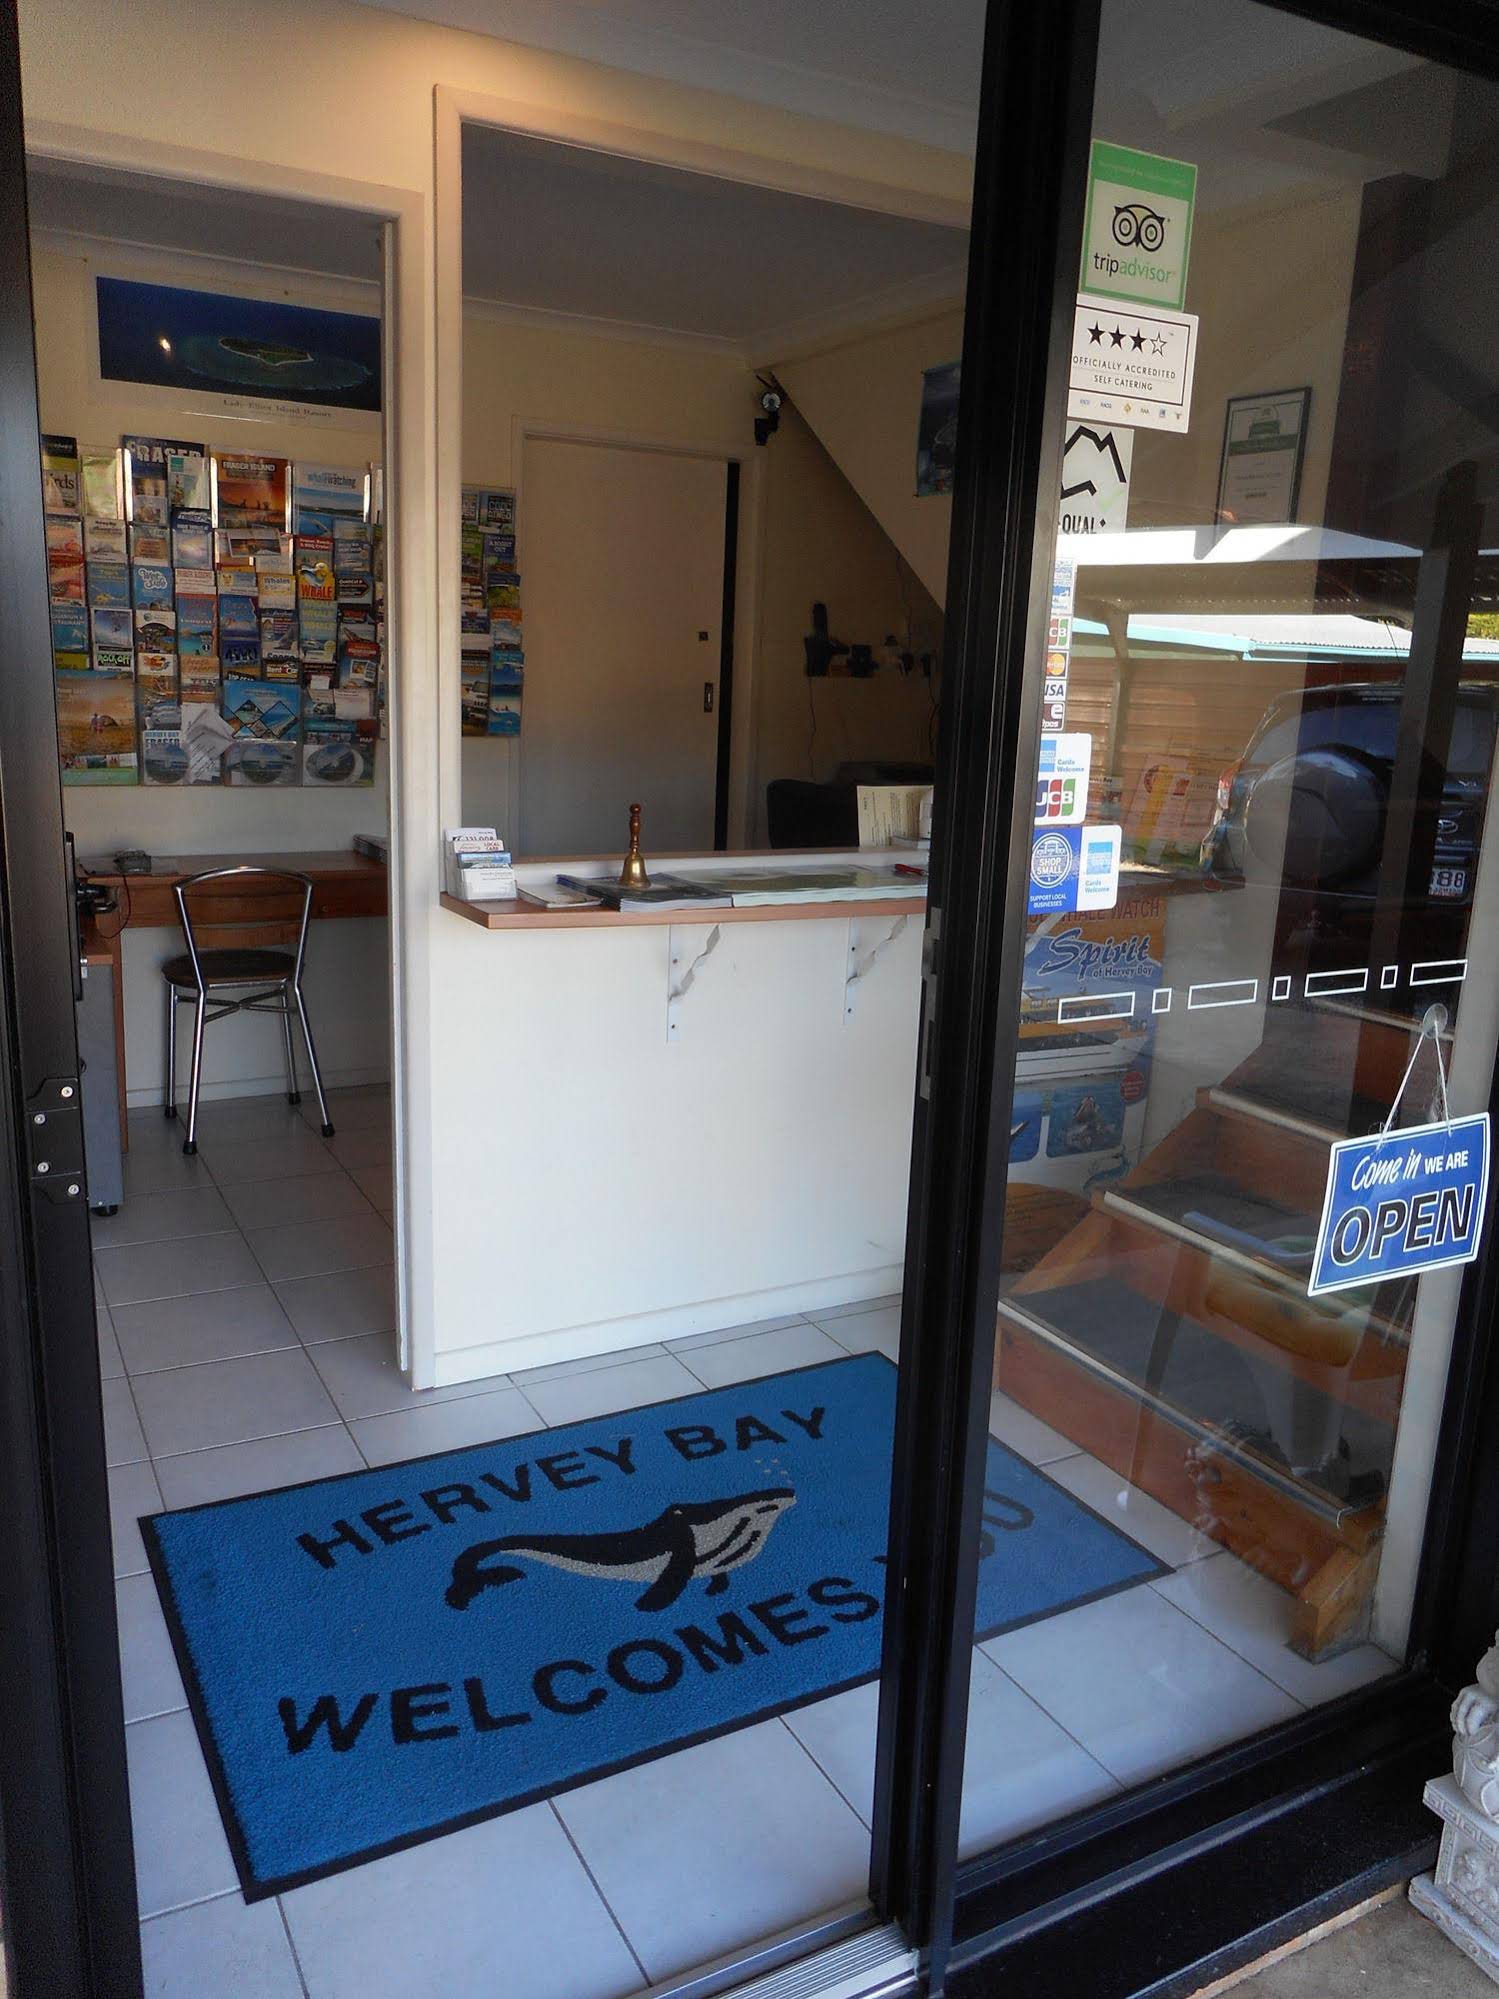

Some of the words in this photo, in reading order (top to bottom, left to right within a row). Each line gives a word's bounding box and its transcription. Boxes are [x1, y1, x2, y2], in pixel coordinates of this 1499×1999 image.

[1093, 252, 1173, 284] tripadvisor
[1072, 355, 1122, 371] OFFICIALLY
[1125, 364, 1176, 379] ACCREDITED
[1093, 374, 1112, 384] SELF
[1114, 378, 1153, 391] CATERING
[301, 583, 333, 598] WHALE
[1044, 684, 1064, 697] ISA
[1036, 791, 1074, 806] JCB
[1036, 866, 1062, 875] SMALL
[1039, 857, 1061, 866] SHOP
[1030, 894, 1052, 902] SUPPORT
[1052, 893, 1066, 901] LOCAL
[1033, 901, 1062, 909] BUSINESSES
[1112, 900, 1160, 921] WATCH
[1037, 927, 1151, 982] Spirit
[1351, 1155, 1402, 1191] Come
[1403, 1148, 1422, 1180] in
[1424, 1157, 1443, 1175] WE
[1445, 1150, 1469, 1170] ARE
[1330, 1183, 1476, 1267] OPEN
[295, 1438, 638, 1569] HERVEY
[664, 1406, 826, 1461] BAY
[278, 1576, 882, 1755] WELCOMES
